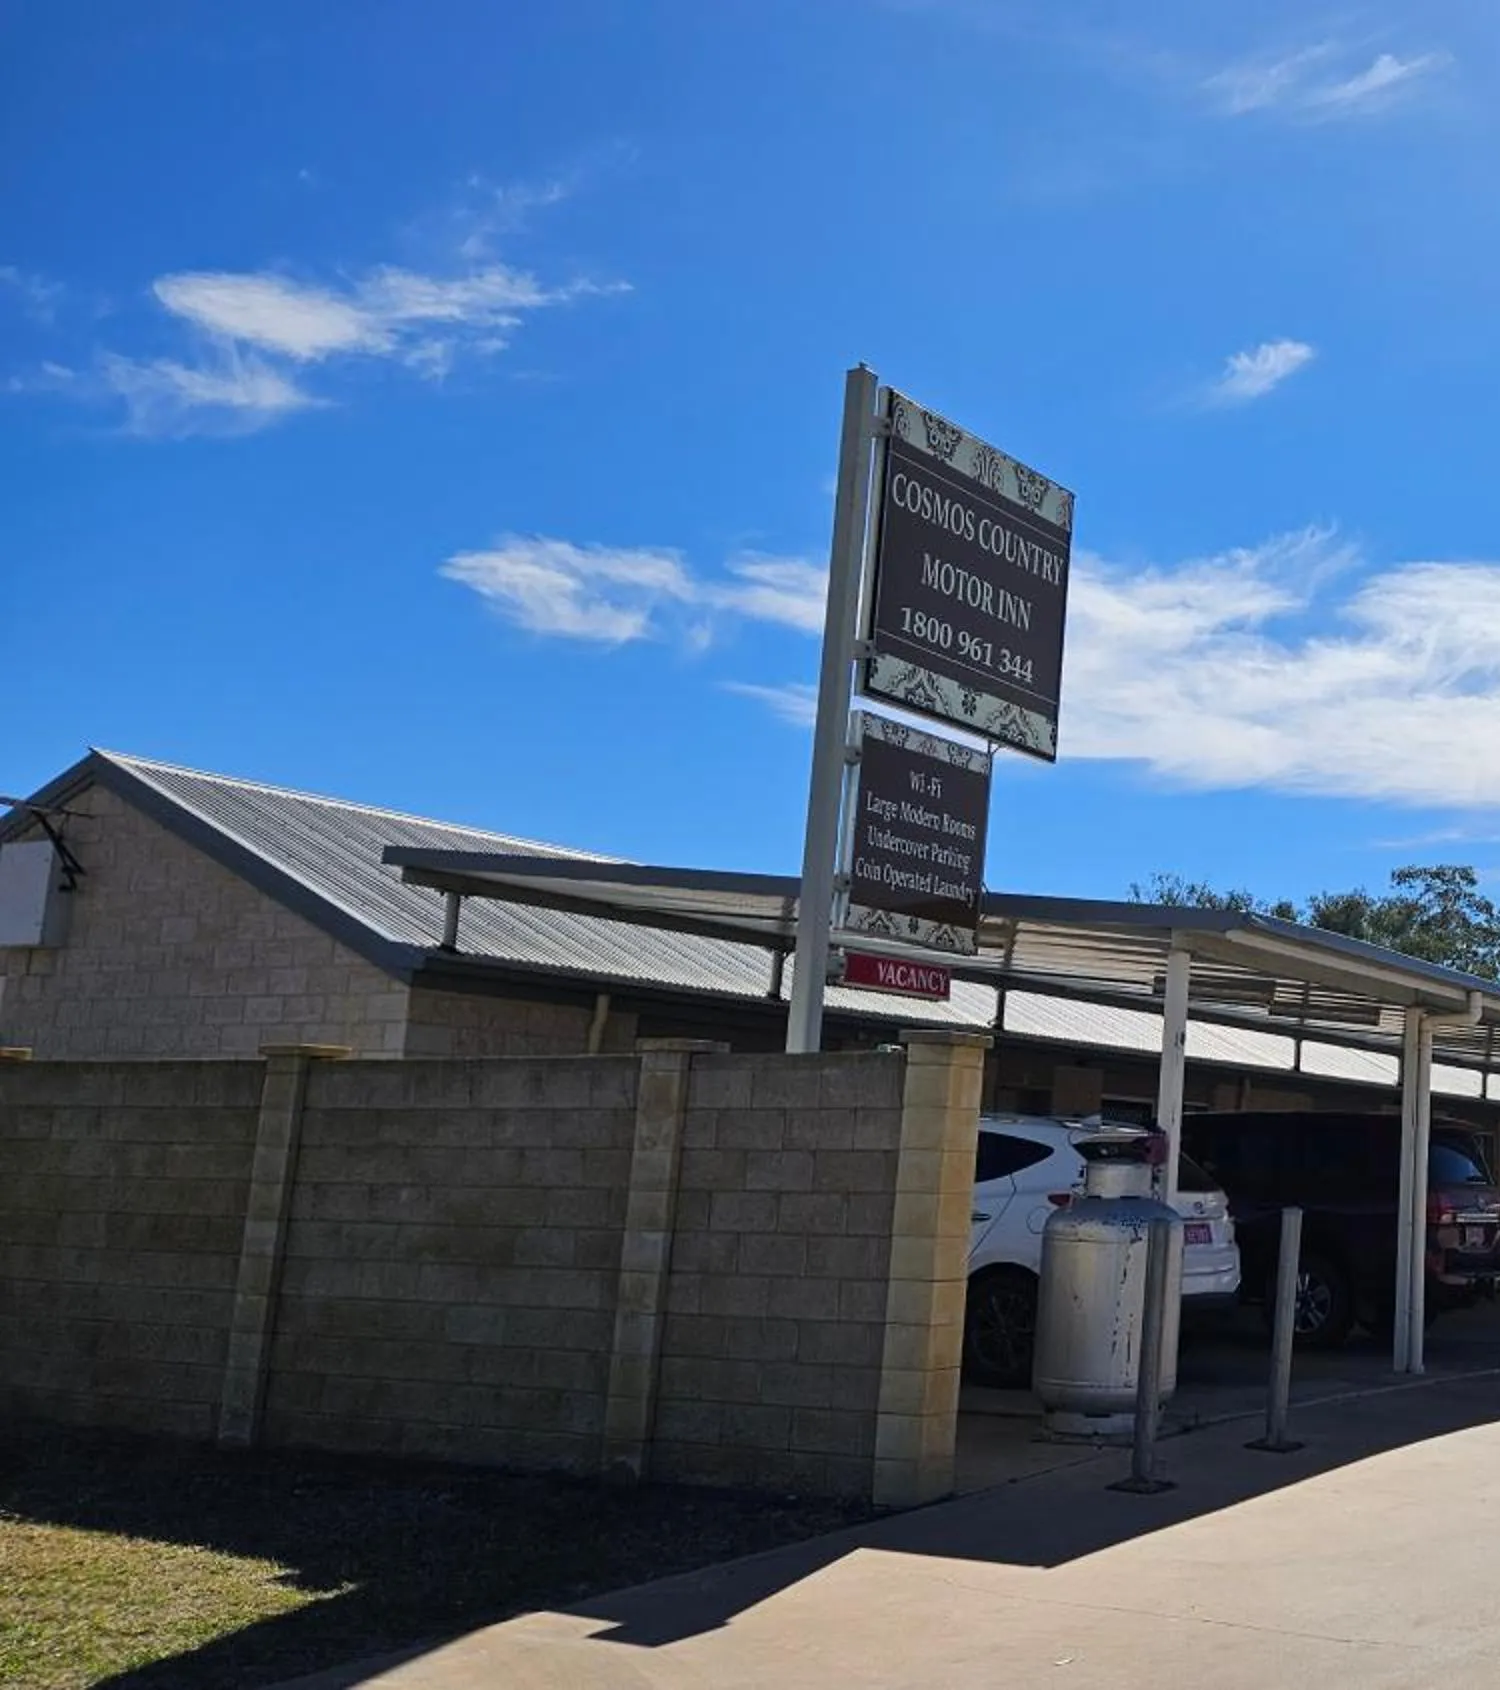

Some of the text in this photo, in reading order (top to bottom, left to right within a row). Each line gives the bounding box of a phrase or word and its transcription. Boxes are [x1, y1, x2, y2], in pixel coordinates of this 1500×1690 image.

[893, 473, 1064, 586] COSMOS COUNTRY
[922, 553, 1032, 631] MOTOR INN
[901, 607, 1032, 685] 1800 961 344
[866, 791, 976, 840] Large Modern Rooms
[868, 826, 972, 875] Undercover Parking
[855, 857, 975, 908] Coin Operated Laundry
[877, 962, 947, 992] VACANCY
